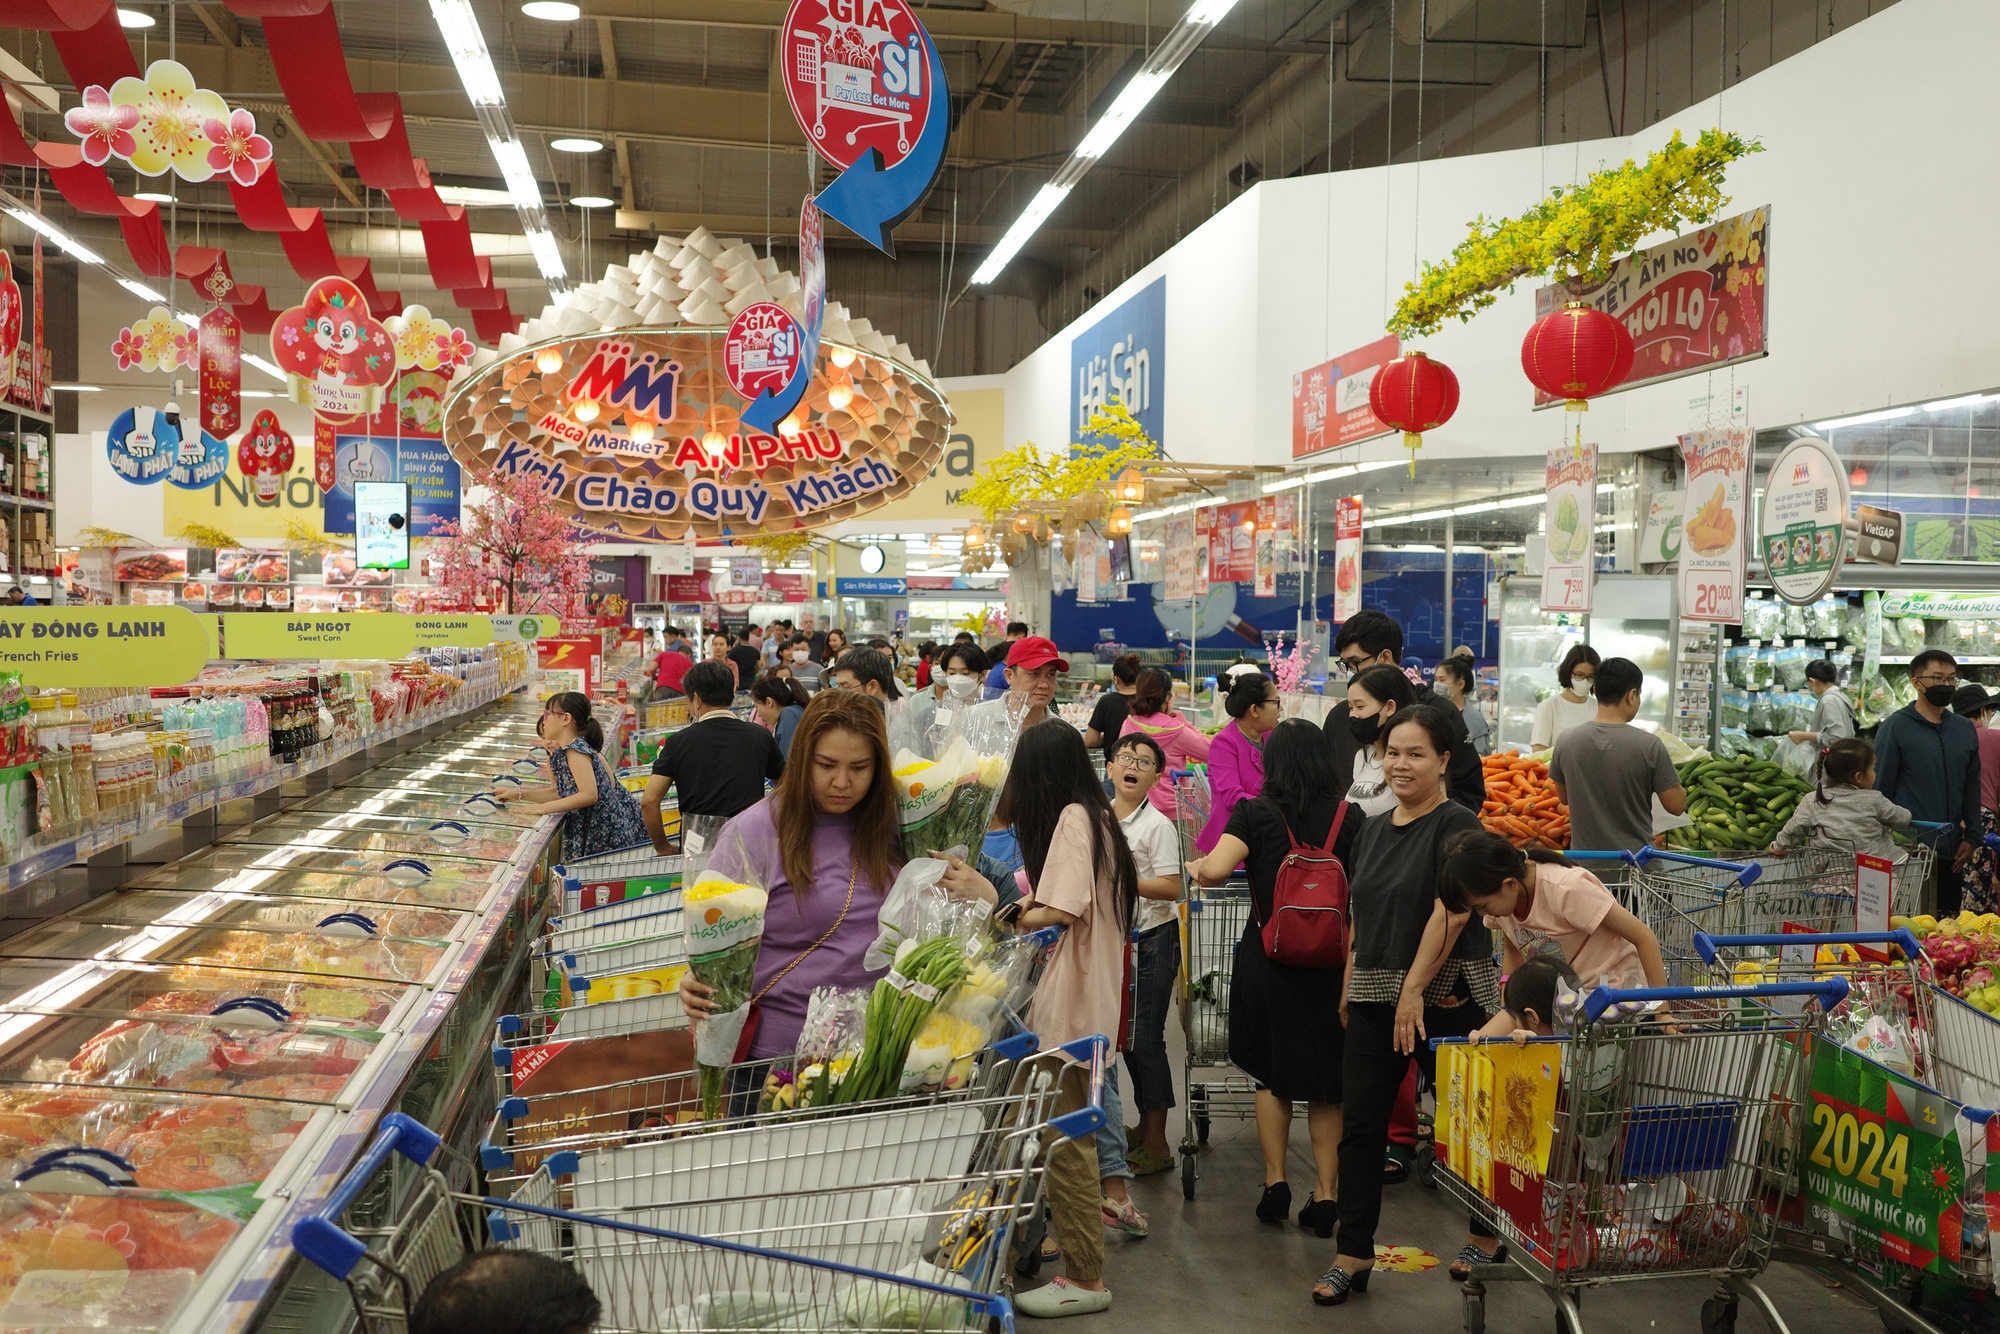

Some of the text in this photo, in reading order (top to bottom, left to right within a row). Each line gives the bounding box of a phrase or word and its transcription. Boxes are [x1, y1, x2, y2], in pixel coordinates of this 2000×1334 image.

[882, 33, 921, 97] SỈ
[836, 85, 910, 110] Pay Less Get More
[1673, 247, 1699, 267] NO
[1675, 287, 1704, 331] LO
[205, 323, 236, 337] Xuân
[746, 312, 777, 331] GIÁ
[206, 342, 235, 356] Sang
[773, 324, 794, 357] SỈ
[209, 377, 231, 391] Lộc
[322, 400, 349, 411] 2024
[750, 422, 842, 466] PHÚ
[142, 449, 174, 478] PHÁT
[399, 449, 450, 461] MUA HÀNG
[194, 456, 225, 484] PHÁT
[428, 490, 454, 498] MINH
[578, 476, 677, 511] Chào
[692, 482, 767, 522] Quý
[786, 457, 894, 513] Khách
[1864, 521, 1895, 539] VietGAP
[594, 573, 616, 583] CUT
[0, 619, 166, 641] ÂY ĐÔNG LẠNH
[315, 622, 351, 634] NGỌT
[415, 620, 468, 630] ĐÔNG LẠNH
[45, 650, 79, 662] Fries
[690, 913, 762, 940] Hasfarm
[515, 1066, 532, 1081] RA
[1512, 1135, 1525, 1153] BIA
[1809, 1103, 1909, 1198] 2024
[1498, 1140, 1539, 1183] SAIGON
[1510, 1168, 1524, 1193] GOLD
[1807, 1169, 1830, 1194] VUI
[1834, 1180, 1871, 1216] XUÂN
[1905, 1211, 1926, 1238] RỠ
